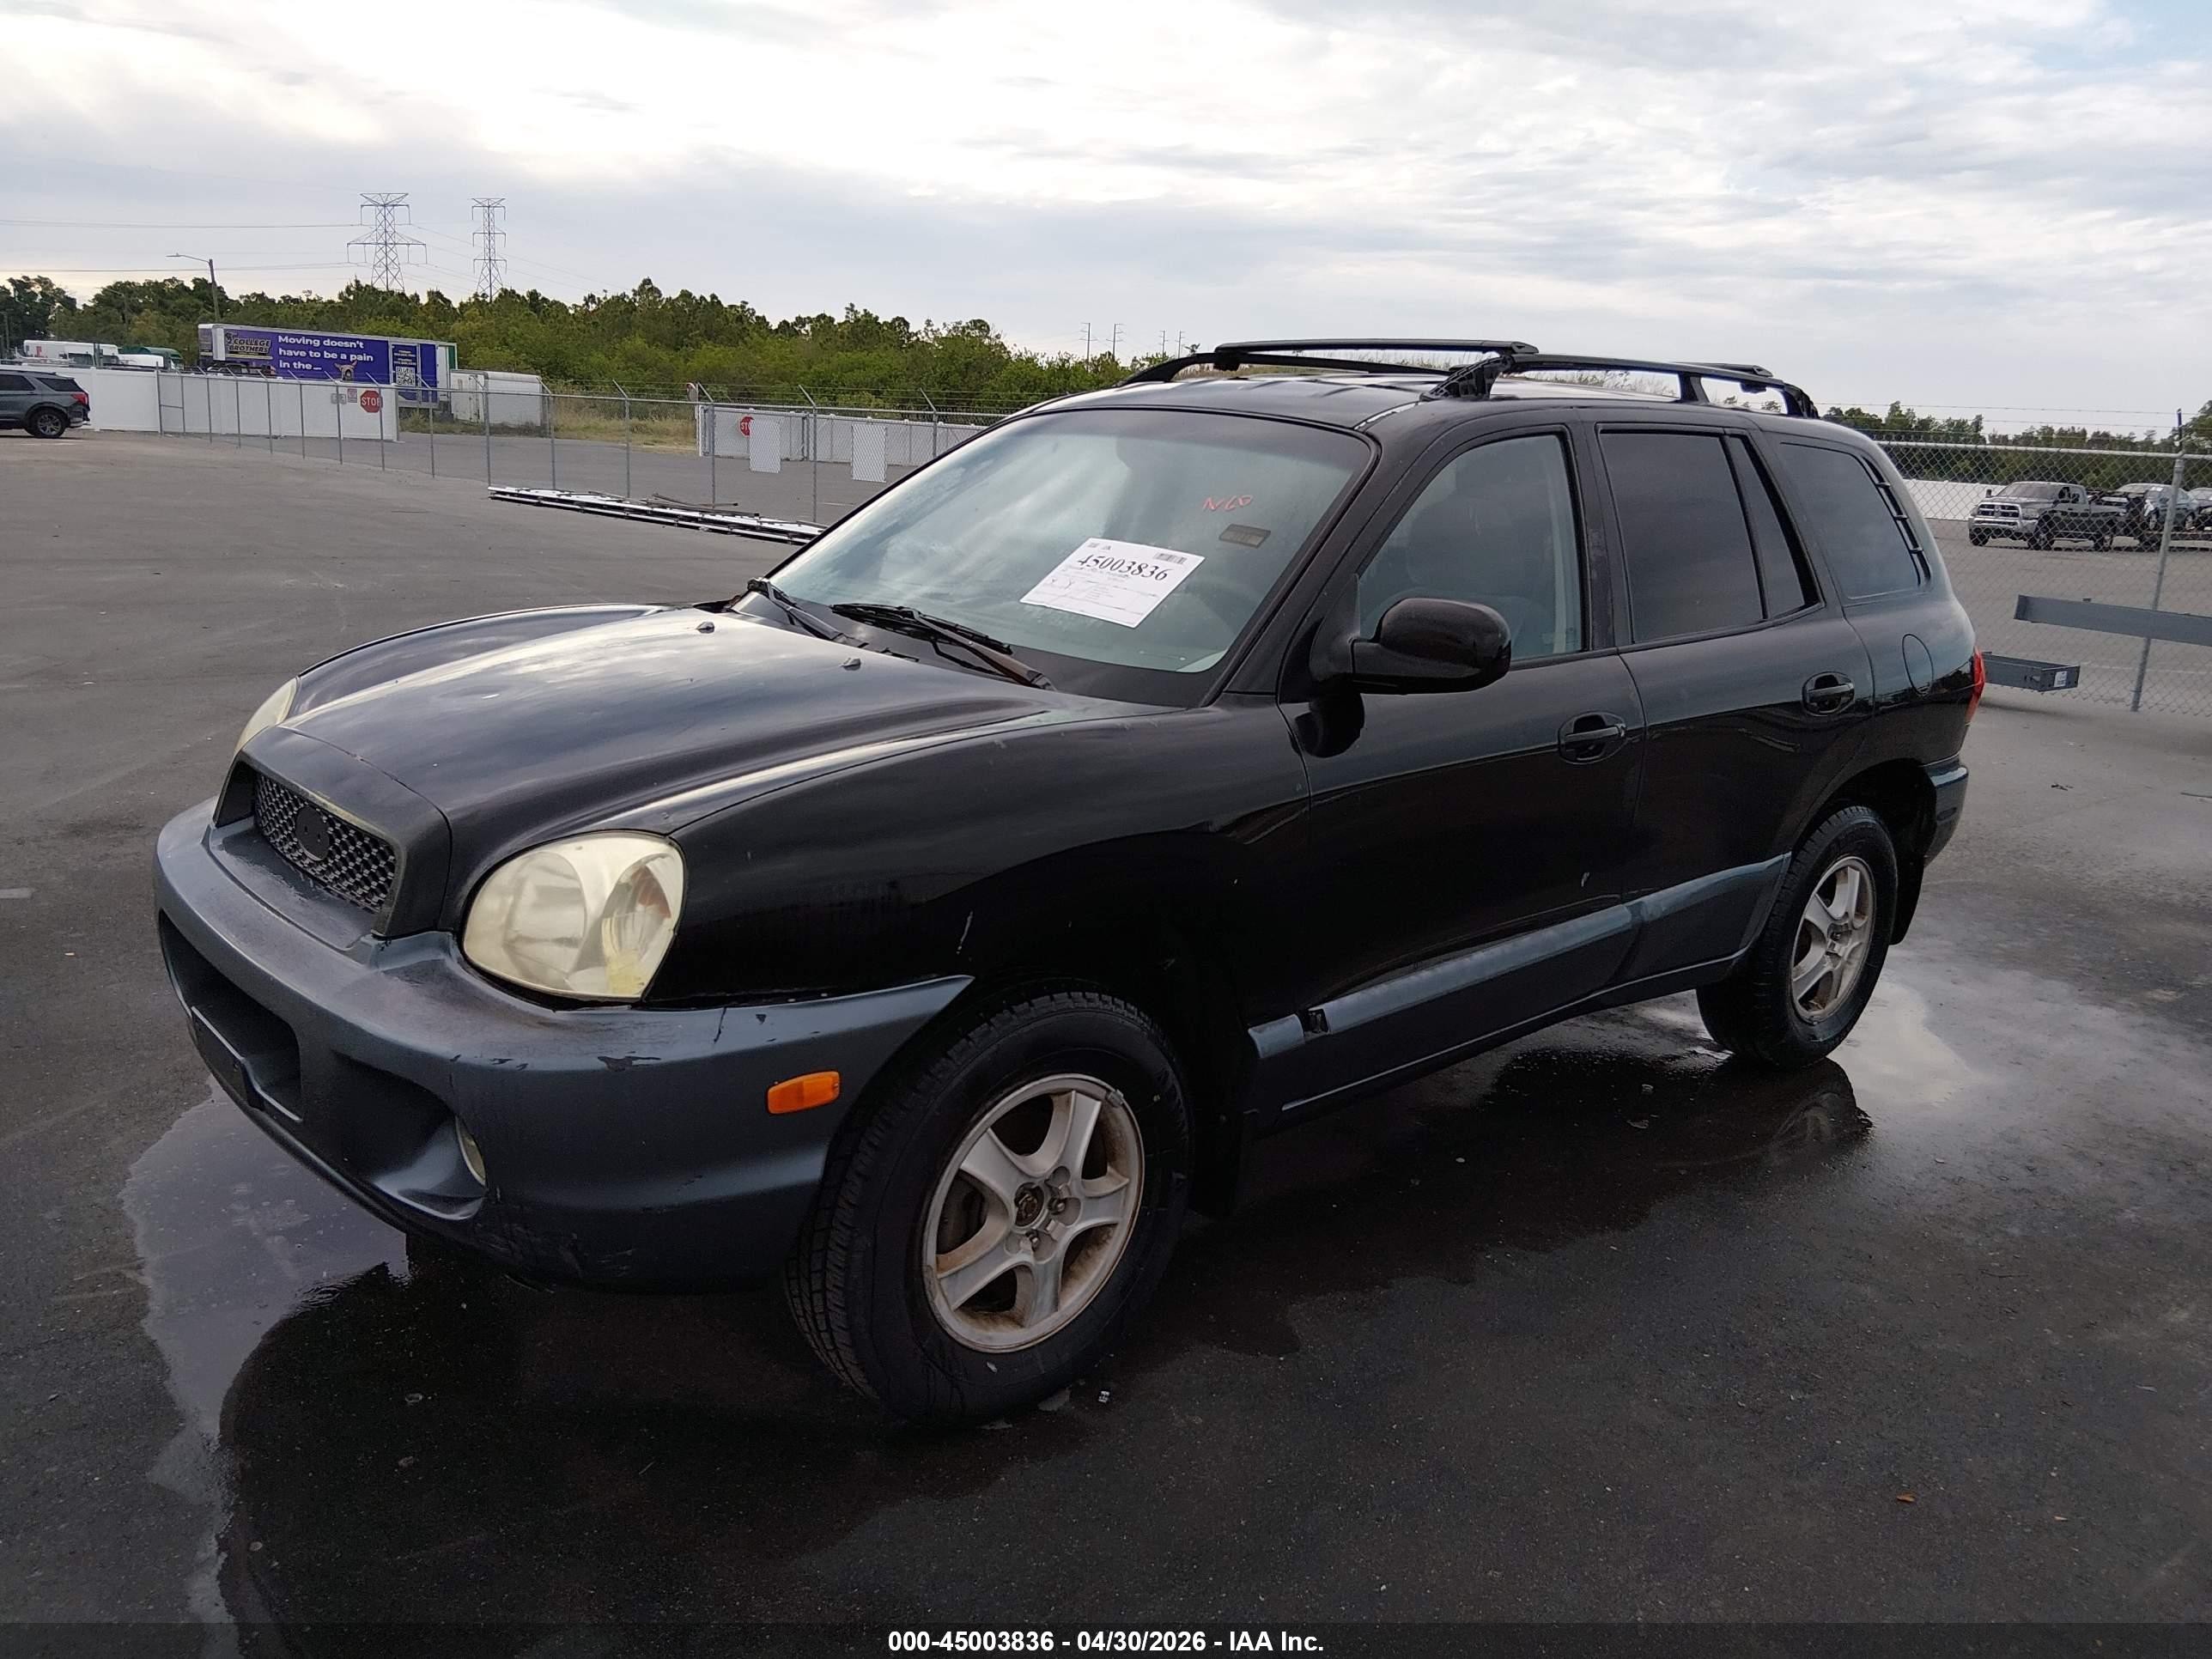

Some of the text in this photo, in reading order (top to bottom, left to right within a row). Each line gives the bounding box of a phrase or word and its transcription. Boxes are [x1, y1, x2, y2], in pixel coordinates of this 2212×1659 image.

[234, 337, 271, 347] COLLEGE
[278, 335, 365, 349] Moving doesn't
[228, 344, 270, 354] BROTHERS
[278, 348, 307, 357] have
[309, 349, 321, 358] to
[324, 350, 337, 359] be
[349, 353, 374, 362] pain
[279, 360, 290, 368] in
[1078, 554, 1174, 581] 45003836
